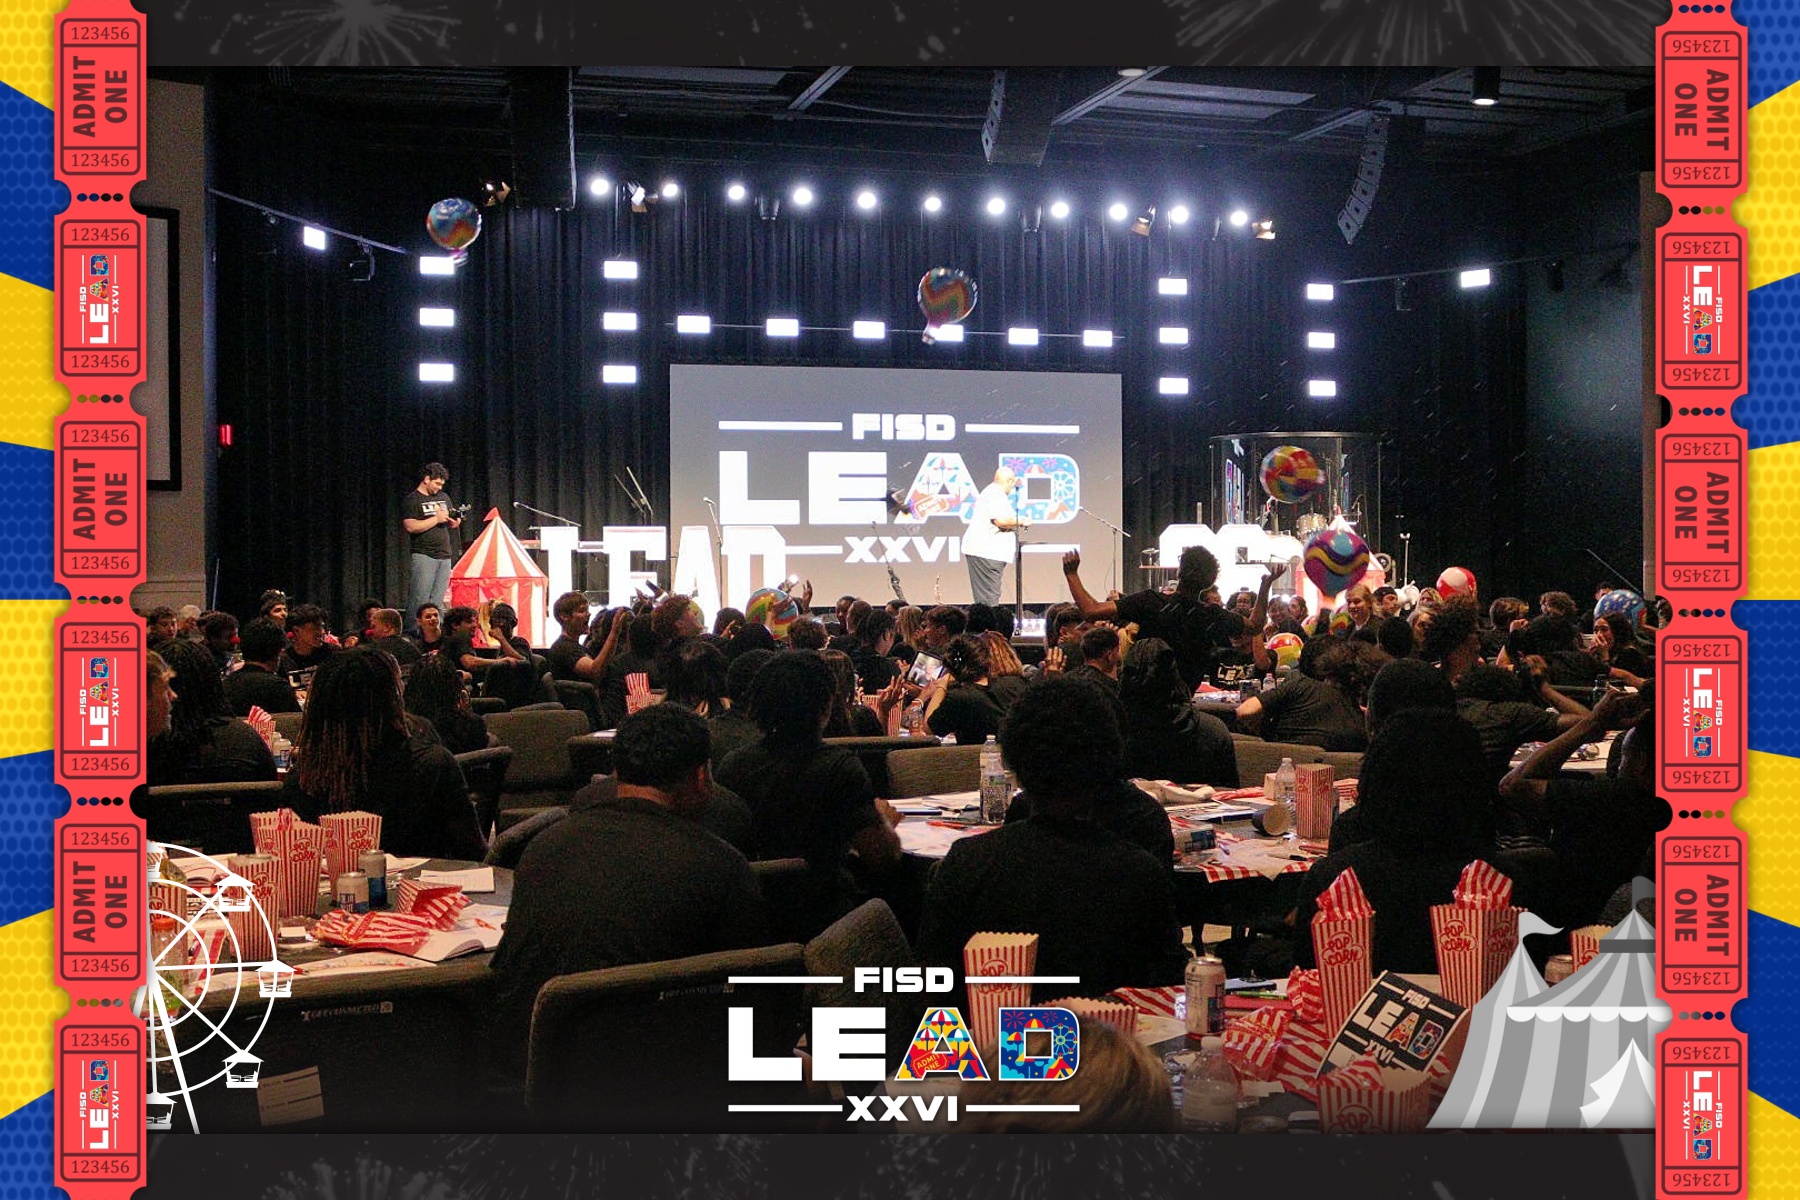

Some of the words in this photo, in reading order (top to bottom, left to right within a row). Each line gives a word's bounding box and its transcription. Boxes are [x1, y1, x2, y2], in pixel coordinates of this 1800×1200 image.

[852, 413, 956, 441] FISD
[719, 450, 1081, 525] LEAD
[844, 536, 961, 564] XXVI
[350, 827, 368, 840] POP
[294, 841, 311, 852] POP
[349, 839, 372, 851] CORN
[291, 850, 316, 863] CORN
[1443, 924, 1464, 938] POP
[1327, 936, 1351, 952] POP
[1442, 939, 1473, 952] CORN
[1326, 948, 1359, 966] CORN
[1402, 989, 1430, 1010] FISD
[1352, 991, 1445, 1061] LEAD
[1364, 1039, 1396, 1064] XXVI
[1336, 1111, 1370, 1130] POP
